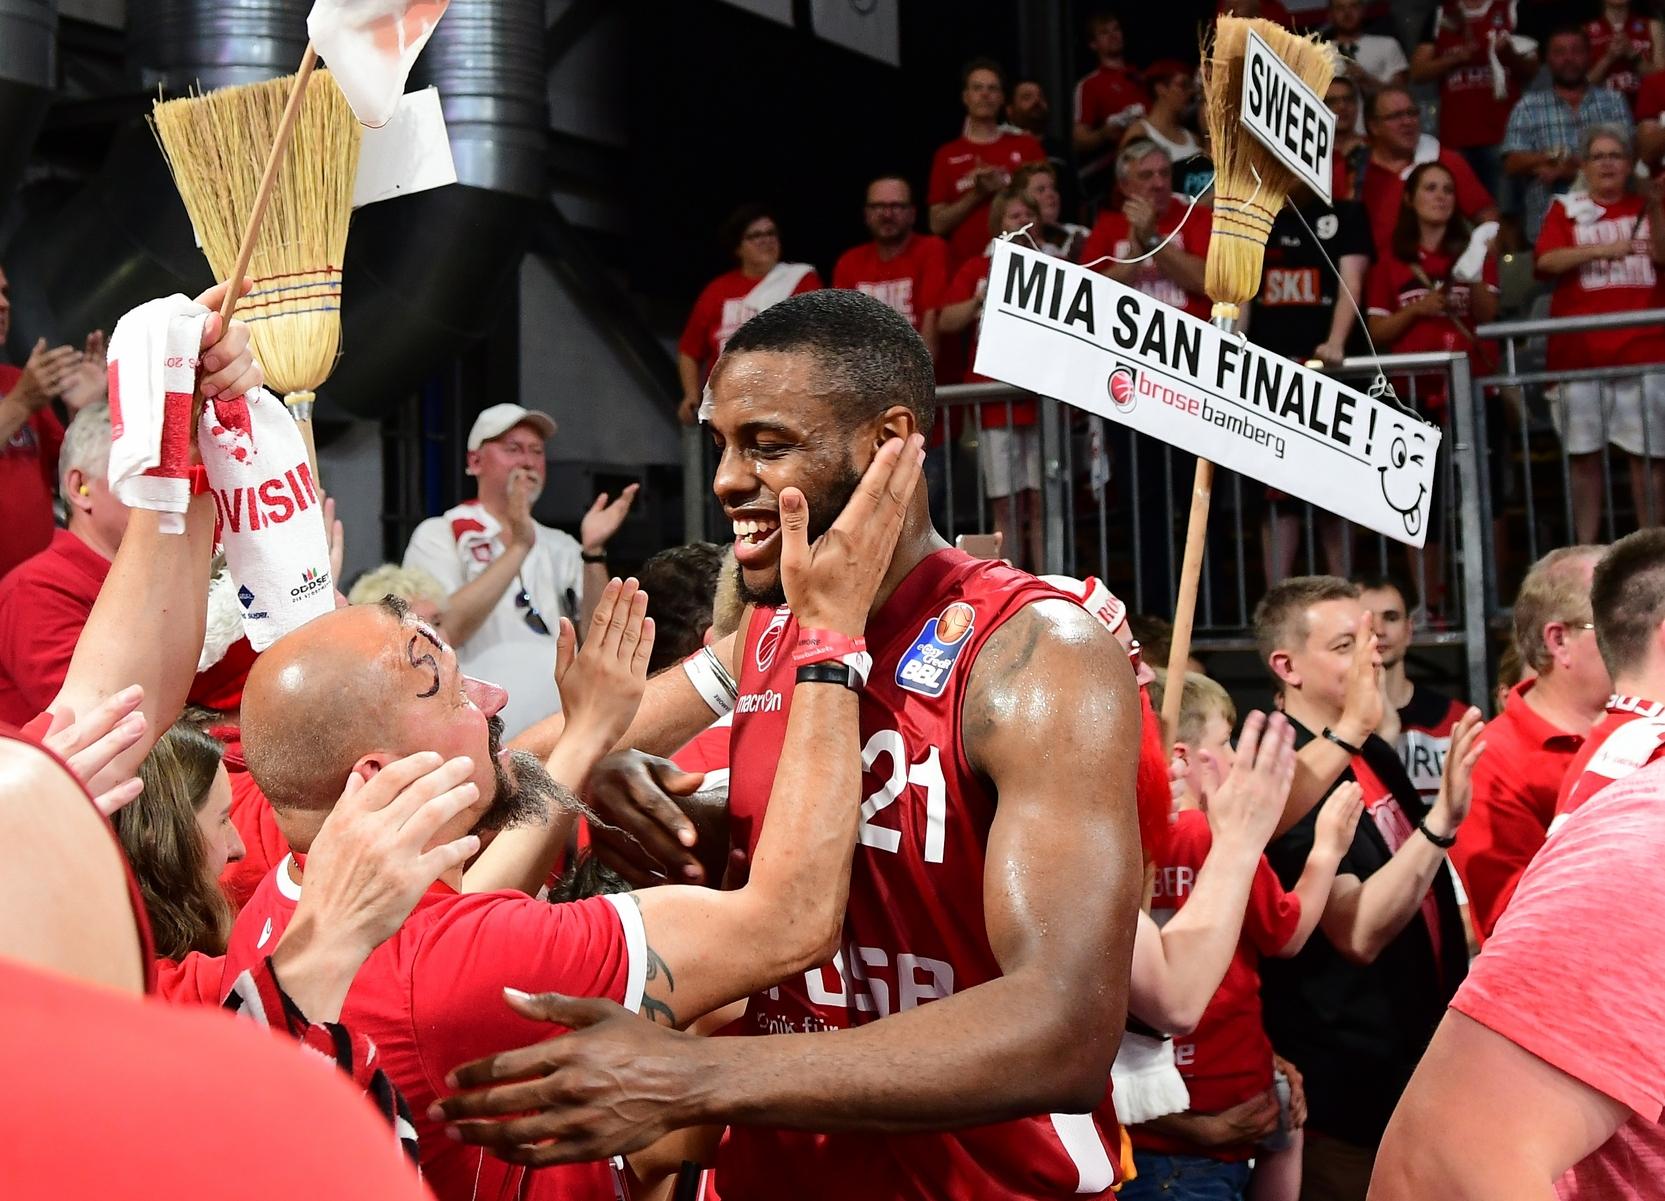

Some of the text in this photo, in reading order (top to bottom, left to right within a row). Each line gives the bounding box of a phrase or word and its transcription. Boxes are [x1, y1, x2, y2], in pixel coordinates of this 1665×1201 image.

[1249, 53, 1328, 175] SWEEP
[1266, 269, 1317, 304] SKL
[1003, 252, 1095, 335] MIA
[1112, 295, 1202, 377] SAN
[1216, 338, 1356, 446] FINALE
[900, 660, 944, 688] BBL
[736, 689, 782, 713] macron
[856, 730, 946, 863] 21
[1151, 866, 1201, 897] BER
[1173, 1044, 1195, 1065] e
